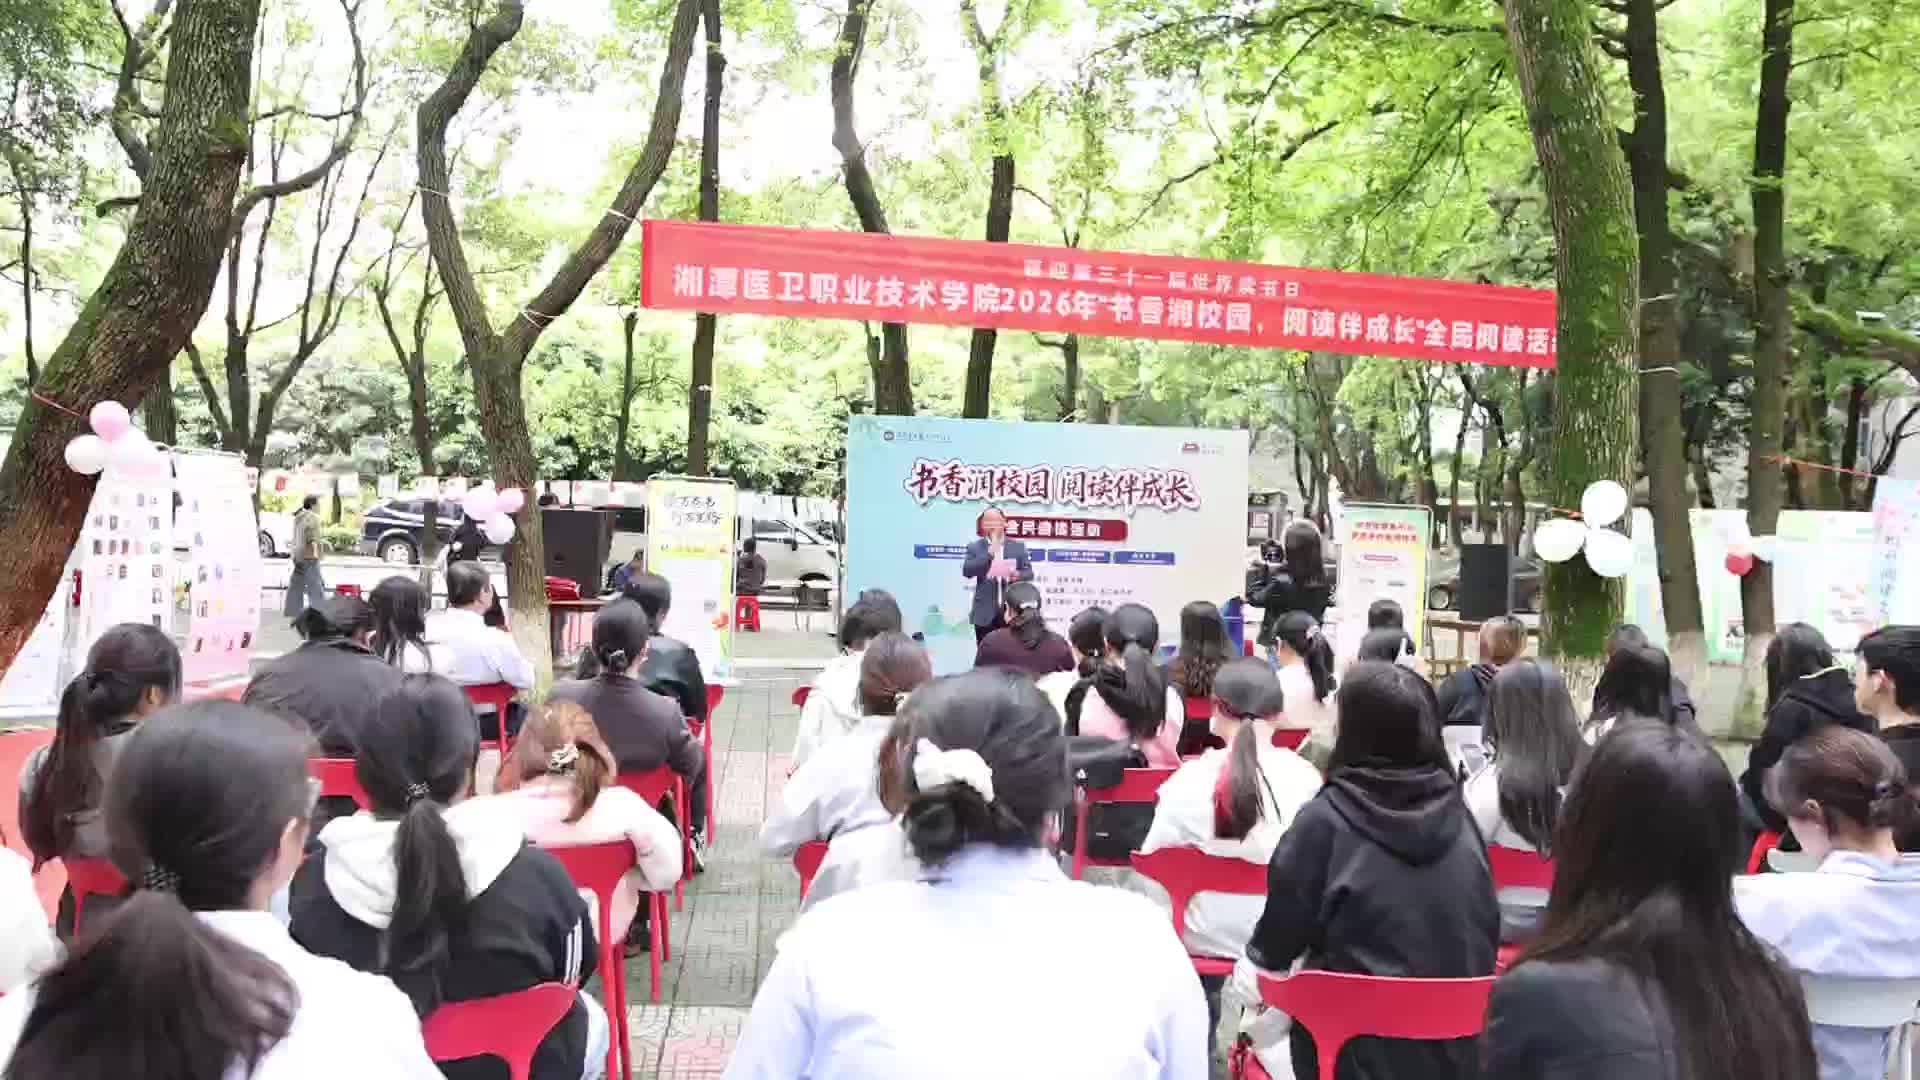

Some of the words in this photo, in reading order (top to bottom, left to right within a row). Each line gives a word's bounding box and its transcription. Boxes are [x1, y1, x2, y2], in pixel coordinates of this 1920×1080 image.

[907, 460, 1050, 502] 书香润校园
[1059, 467, 1196, 508] 阅读伴成长
